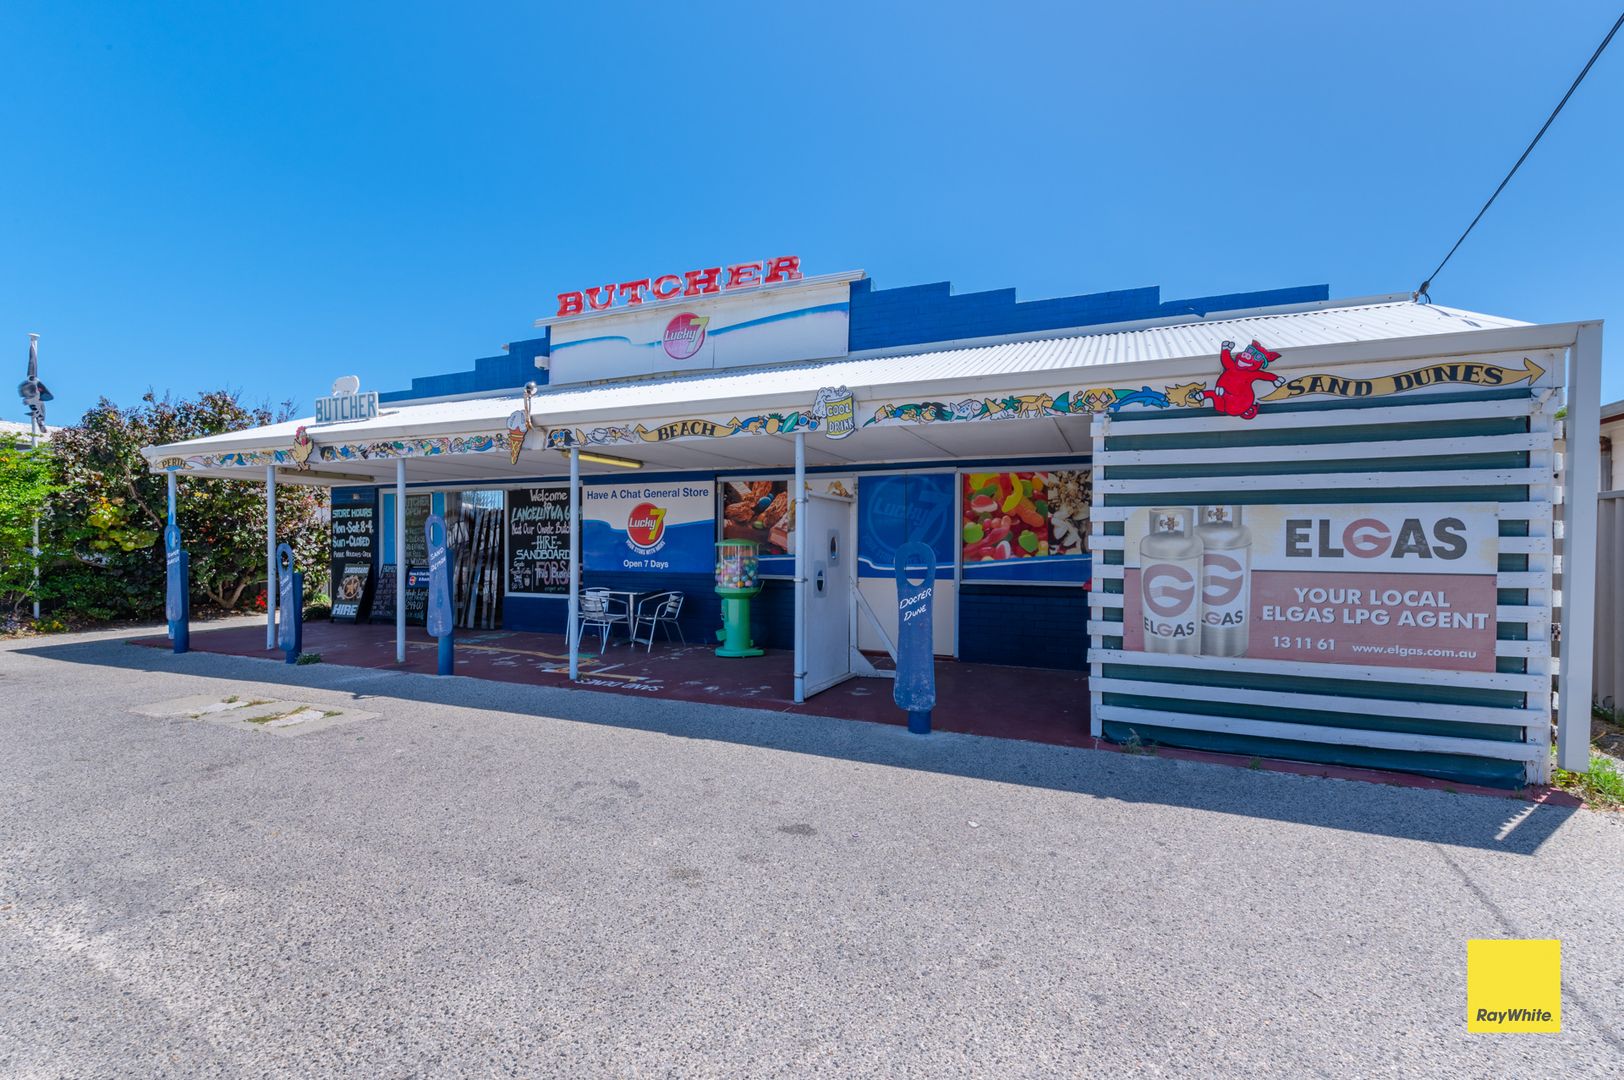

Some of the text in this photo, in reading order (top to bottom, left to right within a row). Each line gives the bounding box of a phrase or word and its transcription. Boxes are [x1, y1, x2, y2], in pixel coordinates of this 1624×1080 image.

[557, 255, 803, 317] BUTCHER
[664, 316, 710, 354] Lucky 7
[1286, 364, 1504, 398] SAND DUNES
[316, 394, 376, 422] BUTCHER
[826, 404, 851, 416] COOL
[658, 422, 716, 442] BEACH
[829, 417, 854, 432] DRINK
[162, 457, 186, 468] PERTH
[530, 489, 568, 502] Welcome
[586, 488, 709, 500] Have A Chat General Store
[332, 508, 372, 518] STORE HOURS
[544, 502, 552, 510] to
[629, 508, 667, 540] Lucky 7
[1286, 517, 1468, 560] ELGAS
[623, 560, 642, 568] Open
[650, 560, 669, 570] Days
[900, 588, 932, 610] DOCTER
[1294, 587, 1451, 608] YOUR LOCAL
[332, 604, 358, 616] HIRE
[904, 604, 927, 622] DUNE
[1262, 606, 1490, 630] ELGAS LPG AGENT
[1144, 616, 1194, 638] ELGAS
[1272, 636, 1477, 659] 13 11 61 www.elgas.com.au
